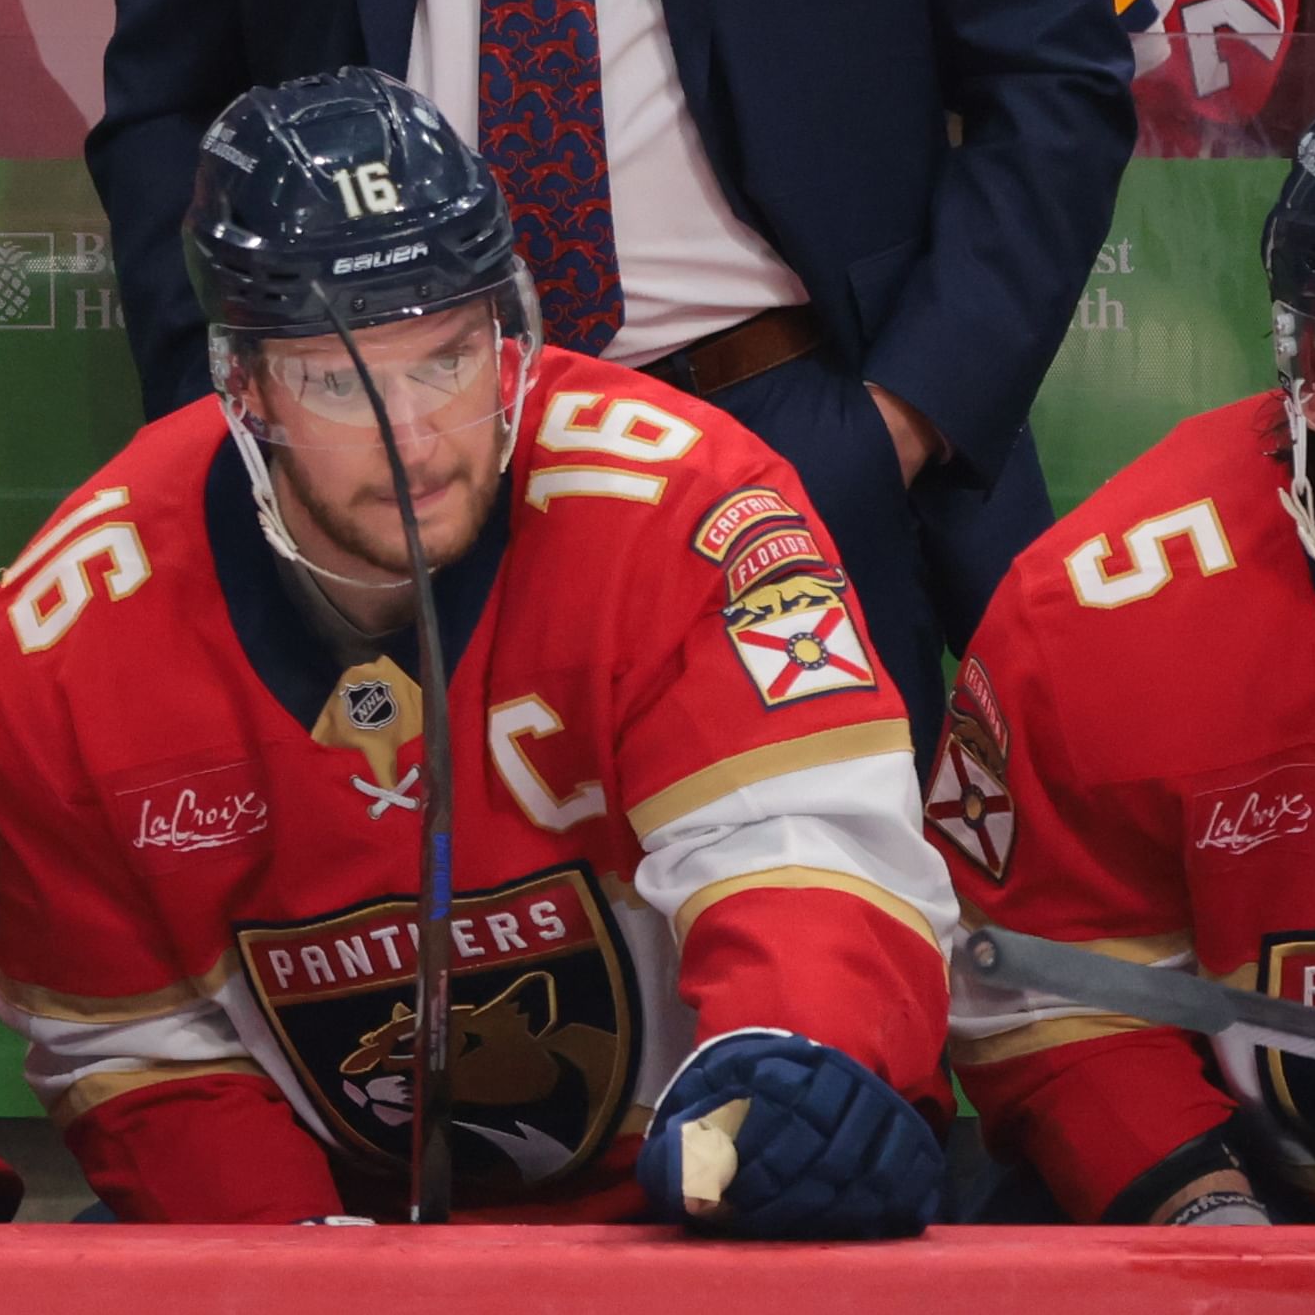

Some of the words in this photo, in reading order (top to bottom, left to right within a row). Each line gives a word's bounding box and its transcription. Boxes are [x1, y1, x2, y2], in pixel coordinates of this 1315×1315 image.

[333, 161, 400, 219] 16
[331, 241, 430, 276] BAUER
[524, 390, 703, 514] 16
[708, 492, 781, 546] CAPTAIN
[736, 534, 810, 586] FLORIDA
[1064, 498, 1237, 610] 5
[357, 690, 383, 720] NHL
[487, 693, 607, 834] C
[132, 788, 268, 852] LaCroix
[1196, 792, 1313, 855] LaCroix
